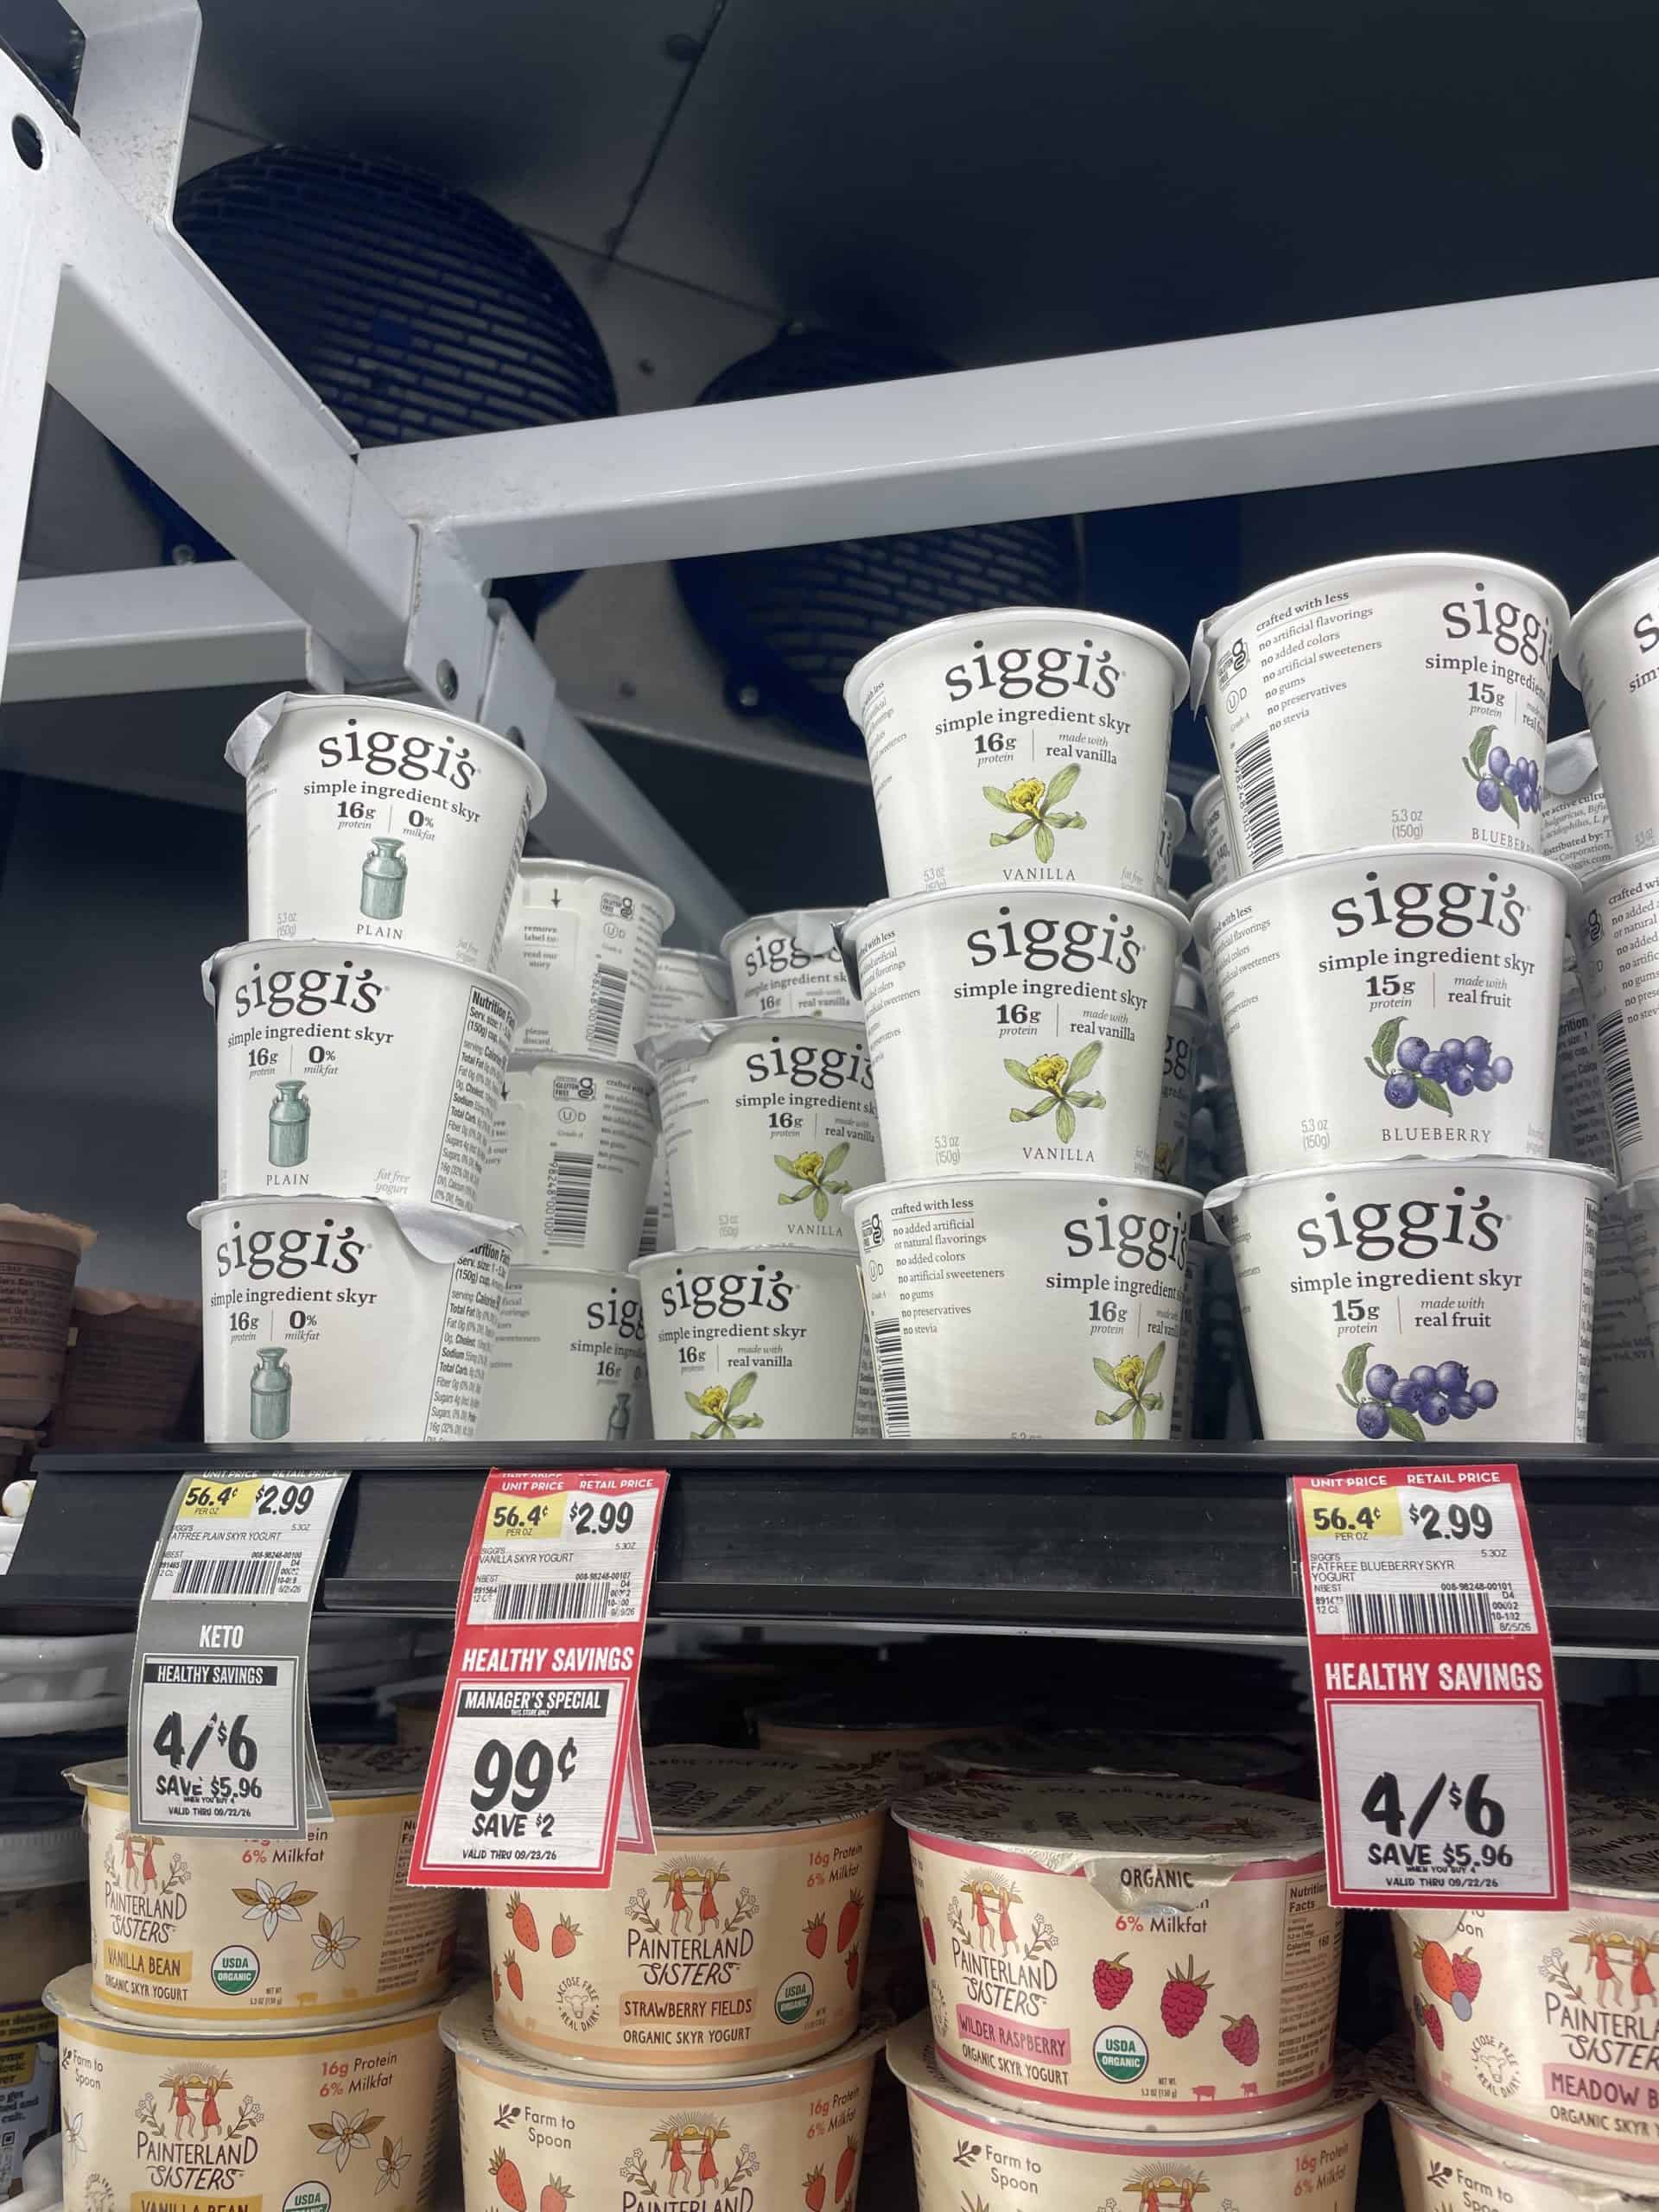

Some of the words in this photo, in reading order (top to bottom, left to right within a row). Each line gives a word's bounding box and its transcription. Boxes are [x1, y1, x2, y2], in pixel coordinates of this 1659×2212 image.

[1258, 639, 1271, 652] no
[1273, 620, 1313, 643] artificial
[1316, 607, 1373, 627] flavorings
[1265, 689, 1278, 700] no
[1279, 676, 1306, 697] gums
[1267, 703, 1280, 715] no
[1281, 681, 1347, 709] preservatives
[1468, 682, 1504, 707] 15g
[935, 709, 994, 735] simple
[999, 706, 1094, 726] ingredient
[1099, 714, 1131, 734] skyr
[1269, 719, 1282, 731] no
[1283, 709, 1310, 727] stevia
[1470, 704, 1503, 719] protein
[974, 732, 1017, 754] 16g
[1058, 733, 1086, 744] made
[1088, 736, 1108, 747] with
[977, 753, 1014, 767] protein
[1046, 745, 1073, 758] real
[1076, 748, 1117, 764] vanilla
[304, 780, 357, 798] simple
[361, 781, 448, 810] ingredient
[450, 804, 480, 824] skyr
[337, 801, 376, 819] 16g
[409, 810, 435, 829] 0%
[1392, 809, 1408, 823] 5.3
[1410, 810, 1423, 822] oz
[338, 820, 372, 830] protein
[403, 827, 436, 842] milkfat
[1392, 823, 1423, 839] (150g)
[1002, 868, 1076, 881] VANILLA
[357, 924, 404, 939] PLAIN
[1319, 948, 1389, 974] simple
[1395, 948, 1501, 967] ingredient
[1503, 953, 1535, 974] skyr
[1366, 974, 1415, 997] 15g
[1454, 976, 1483, 988] made
[1484, 978, 1507, 989] with
[1369, 995, 1412, 1012] protein
[1448, 989, 1478, 1004] real
[1480, 990, 1511, 1007] fruit
[995, 1003, 1042, 1024] 16g
[999, 1025, 1037, 1039] protein
[249, 1047, 278, 1067] 16g
[309, 1046, 336, 1064] 0%
[769, 1113, 803, 1128] 16g
[1382, 1127, 1491, 1142] BLUEBERRY
[1022, 1147, 1095, 1162] VANILLA
[266, 1174, 309, 1185] PLAIN
[891, 1203, 921, 1215] crafted
[924, 1199, 949, 1211] with
[950, 1198, 974, 1210] less
[788, 1224, 842, 1237] VANILLA
[893, 1226, 904, 1236] no
[906, 1222, 931, 1234] added
[933, 1218, 975, 1231] artificial
[904, 1236, 933, 1249] natural
[935, 1233, 987, 1247] flavorings
[896, 1256, 906, 1267] no
[908, 1254, 933, 1265] added
[935, 1250, 966, 1263] colors
[229, 1312, 259, 1331] 16g
[289, 1311, 317, 1329] 0%
[1089, 1300, 1128, 1323] 16g
[1332, 1299, 1379, 1322] 15g
[658, 1326, 690, 1343] simple
[693, 1324, 770, 1339] ingredient
[773, 1325, 806, 1340] skyr
[679, 1346, 706, 1363] 16g
[728, 1357, 749, 1367] real
[753, 1356, 792, 1367] vanilla
[186, 1486, 238, 1506] 56.4¢
[256, 1484, 314, 1515] $2.99
[493, 1505, 548, 1528] 56.4¢
[569, 1501, 634, 1535] $2.99
[1313, 1507, 1382, 1531] 56.4¢
[1409, 1503, 1492, 1541] $2.99
[523, 1528, 532, 1536] OZ
[1356, 1532, 1369, 1541] OZ
[480, 1554, 514, 1563] VANILLA
[514, 1554, 537, 1563] SKYR
[537, 1553, 574, 1562] YOGURT
[1311, 1562, 1358, 1572] FATFREE
[1361, 1561, 1424, 1571] BLUEBERRY
[1426, 1560, 1455, 1570] SKYR
[1312, 1573, 1355, 1582] YOGURT
[200, 1624, 244, 1649] KETO
[461, 1648, 548, 1672] HEALTHY
[551, 1647, 634, 1672] SAVINGS
[157, 1665, 209, 1683] HEALTHY
[213, 1666, 264, 1683] SAVINGS
[1325, 1663, 1428, 1691] HEALTHY
[1438, 1662, 1543, 1690] SAVINGS
[465, 1692, 544, 1709] MANAGER'S
[548, 1692, 601, 1709] SPECIAL
[153, 1711, 257, 1771] 4/$6
[470, 1737, 577, 1812] 99¢
[156, 1775, 202, 1796] SAVE
[211, 1776, 262, 1798] $5.96
[1362, 1772, 1505, 1840] 4/$6
[472, 1813, 526, 1837] SAVE
[536, 1813, 555, 1837] $2
[463, 1849, 486, 1859] VALID
[491, 1850, 512, 1859] THRU
[514, 1851, 556, 1859] 09/23/26
[1369, 1843, 1431, 1866] SAVE
[1443, 1843, 1513, 1867] $5.96
[1122, 1869, 1192, 1889] ORGANIC
[105, 1881, 188, 1920] PAINTERLAND
[111, 1915, 176, 1943] SISTERS
[1115, 1915, 1144, 1933] 6%
[1149, 1915, 1207, 1934] Milkfat
[627, 1929, 753, 1960] PAINTERLAND
[107, 1950, 145, 1972] VANILLA
[149, 1956, 181, 1976] BEAN
[222, 1957, 249, 1970] USDA
[638, 1961, 740, 1986] SISTERS
[952, 1939, 1058, 1991] PAINTERLAND
[217, 1972, 251, 1981] ORGANIC
[105, 1974, 129, 1994] ORGANIC
[130, 1980, 150, 1999] SKYR
[153, 1986, 188, 2001] YOGURT
[963, 1975, 1047, 2017] SISTERS
[624, 2001, 706, 2018] STRAWBERRY
[711, 1999, 753, 2015] FIELDS
[623, 2029, 673, 2044] ORGANIC
[677, 2030, 704, 2044] SKYR
[708, 2027, 751, 2044] YOGURT
[959, 2015, 995, 2044] WILDER
[999, 2027, 1065, 2057] RASPBERRY
[321, 2060, 349, 2078] 16g
[353, 2052, 397, 2072] Protein
[320, 2082, 344, 2098] 6%
[348, 2074, 393, 2095] Milkfat
[1550, 2073, 1642, 2107] MEADOW
[986, 2145, 1022, 2169] Farm
[1026, 2157, 1042, 2174] to
[991, 2166, 1039, 2194] Spoon
